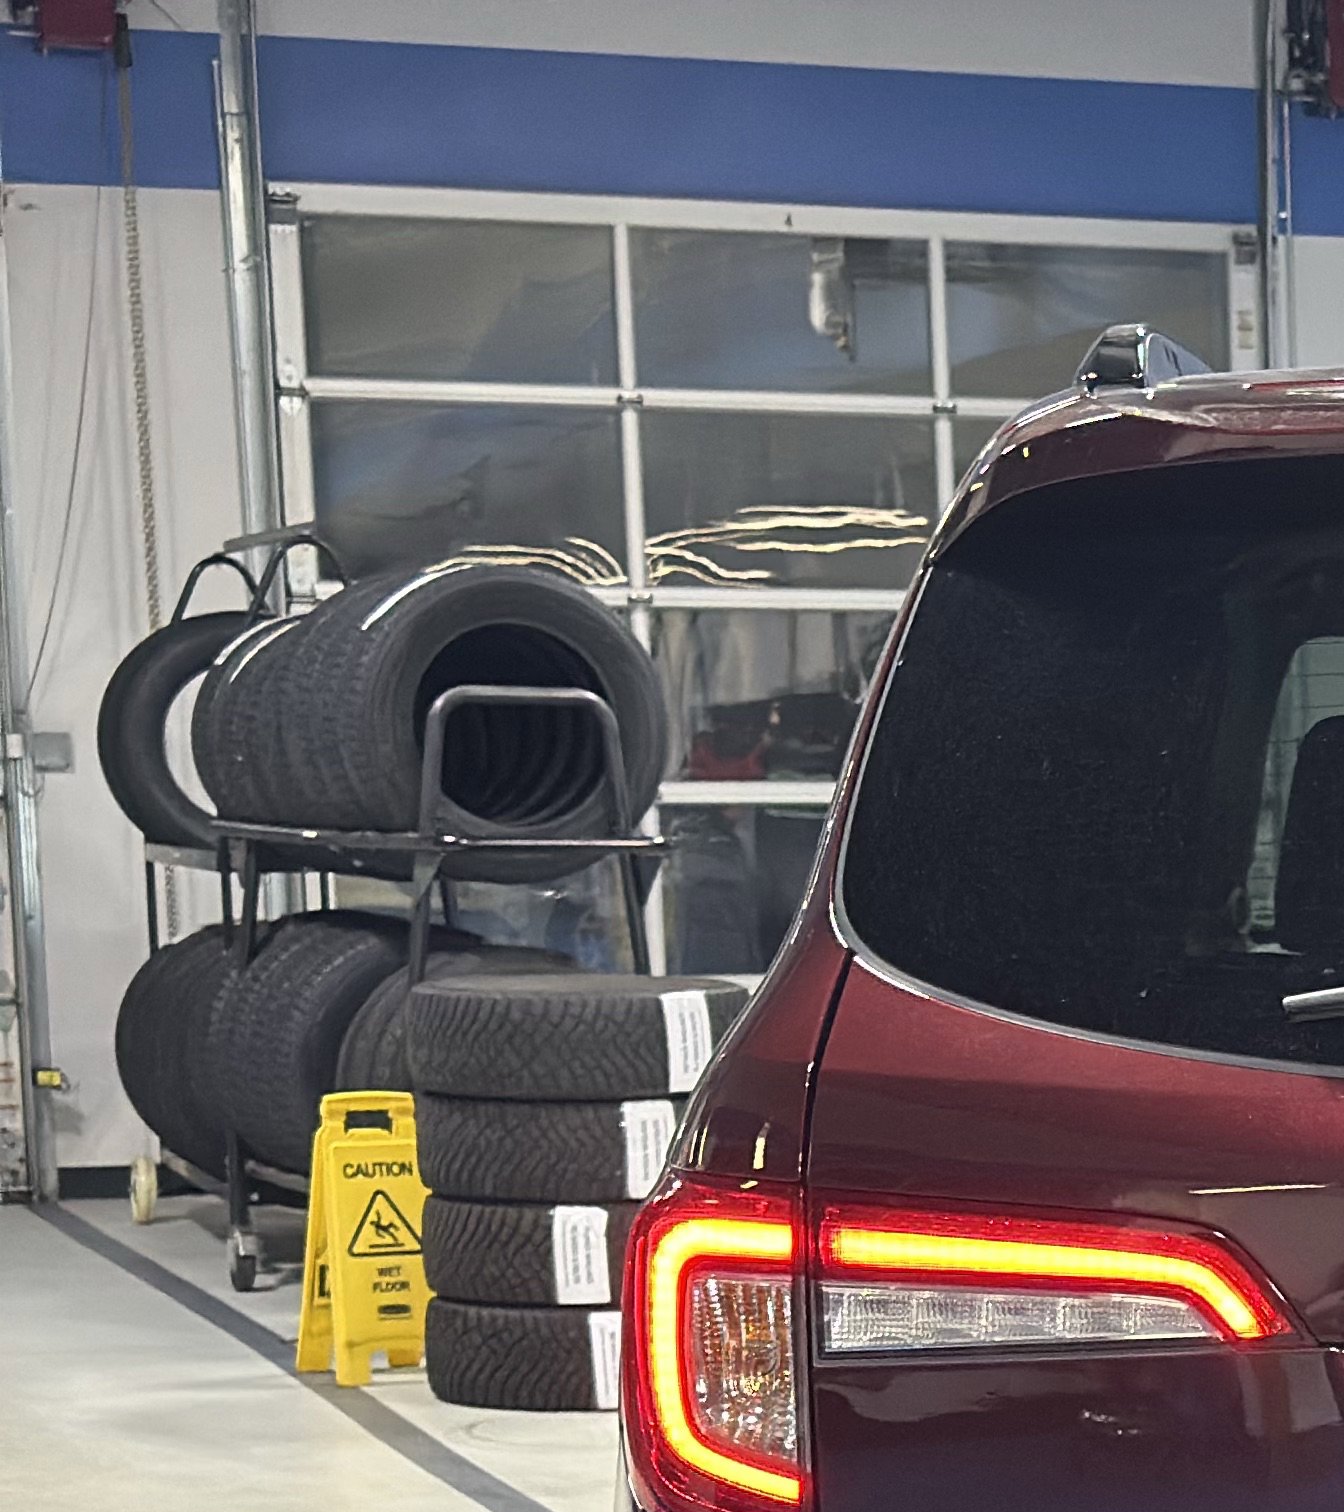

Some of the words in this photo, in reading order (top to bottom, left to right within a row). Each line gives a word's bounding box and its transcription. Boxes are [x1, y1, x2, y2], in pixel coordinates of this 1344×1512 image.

[343, 1161, 413, 1179] CAUTION
[377, 1266, 401, 1278] WET
[373, 1281, 411, 1293] FLOOR
